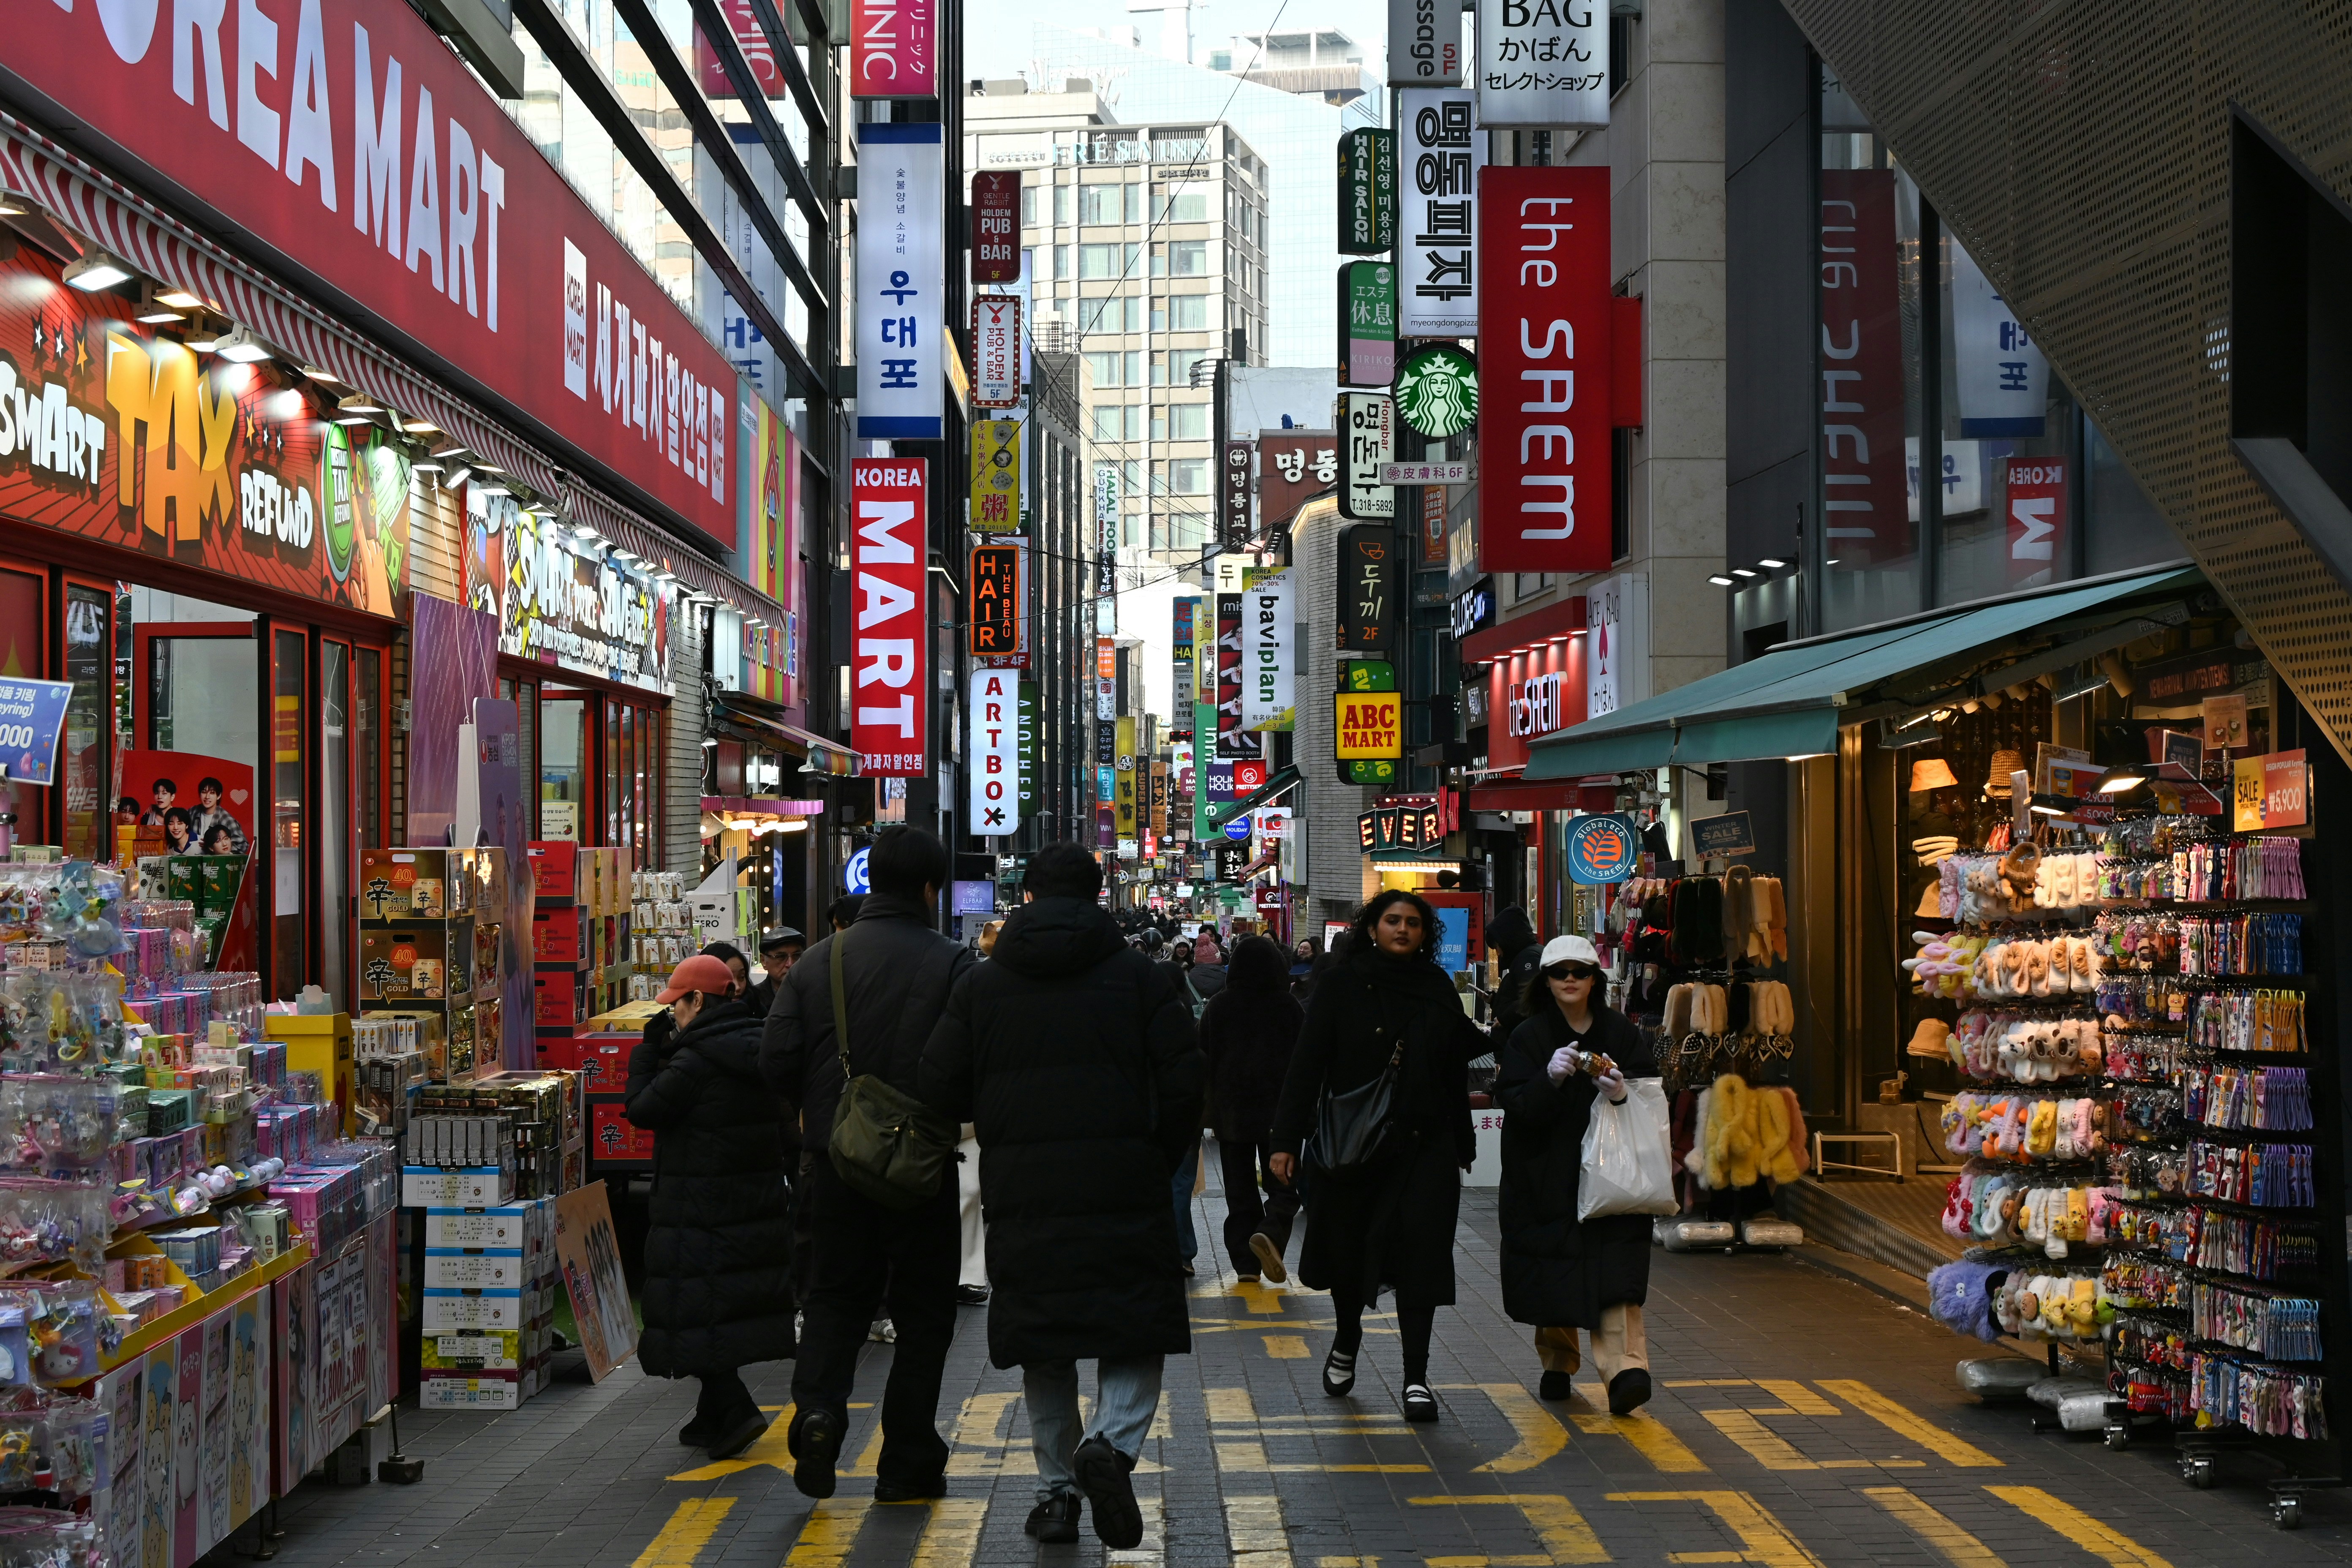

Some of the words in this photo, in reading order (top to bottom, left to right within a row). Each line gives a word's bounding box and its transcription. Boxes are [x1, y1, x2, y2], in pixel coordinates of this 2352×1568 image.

[1503, 0, 1592, 27] BAG
[1443, 44, 1456, 75] 5F
[1499, 36, 1591, 63] かばん
[1485, 72, 1604, 91] セレクトショップ
[1355, 135, 1367, 181] HAIR
[1377, 137, 1390, 190] 김선영
[354, 21, 504, 333] MART
[896, 168, 906, 214] 숯불양념
[1416, 101, 1472, 302] 명동피자
[981, 218, 1011, 234] PUB
[1354, 185, 1368, 243] SALON
[1377, 195, 1392, 245] 미용실
[896, 221, 906, 255] 소갈비
[1521, 198, 1573, 288] the
[981, 245, 1011, 260] BAR
[991, 270, 1000, 279] 5F
[1375, 272, 1390, 280] 明洞
[566, 272, 584, 318] KOREA
[1356, 286, 1388, 298] エステ
[1351, 300, 1393, 325] 休息
[1411, 319, 1478, 328] myeongdongpizza
[880, 270, 917, 388] 우대포
[566, 326, 584, 369] MART
[995, 328, 1004, 380] HOLDEM
[1352, 354, 1391, 365] KIRIKO
[594, 281, 707, 487] 세계과자할인점
[1338, 373, 1346, 383] 4F
[990, 389, 1001, 398] 5F
[1339, 396, 1346, 406] 3F
[0, 361, 105, 485] SMART
[106, 329, 236, 541] TAX
[241, 471, 313, 549] REFUND
[713, 411, 723, 445] KOREA
[1381, 400, 1390, 451] Hongbar
[331, 447, 347, 467] INSTANT
[1353, 403, 1380, 495] 명돈가
[713, 457, 723, 483] MART
[855, 468, 921, 487] KOREA
[1275, 448, 1337, 483] 명동
[1403, 466, 1446, 480] 皮膚科
[1449, 467, 1463, 478] 6F
[332, 468, 348, 502] TAX
[1106, 470, 1115, 514] HALAL
[334, 504, 350, 525] REFUND
[981, 493, 1009, 523] 粥
[1352, 499, 1393, 512] T.318-5892
[1449, 529, 1460, 577] JUNO
[1460, 517, 1473, 567] HAIR
[520, 528, 574, 617] SMART
[574, 579, 597, 630] PRICE
[600, 562, 635, 645] SAVE
[632, 603, 645, 646] BIG
[1359, 564, 1383, 621] 두끼
[979, 555, 997, 647] HAIR
[1176, 602, 1192, 626] 足
[1451, 589, 1473, 640] FULORE
[529, 618, 542, 646] SKIP
[858, 501, 915, 738] MART
[1337, 636, 1345, 648] 2F
[1363, 627, 1379, 640] 2F
[993, 656, 1007, 666] 3F
[1011, 656, 1025, 665] 4F
[1258, 596, 1279, 702] baviplan
[1338, 662, 1345, 672] 1F
[14, 689, 36, 702] 키링
[1594, 683, 1614, 714] かばん
[1343, 704, 1394, 730] ABC
[1509, 684, 1523, 737] the
[984, 677, 1005, 826] ARTBOX
[1019, 700, 1031, 800] ANOTHER
[1343, 731, 1395, 748] MART
[2173, 745, 2194, 754] WINTER
[2170, 753, 2195, 768] SALE
[2266, 762, 2277, 771] DESIGN
[2277, 760, 2291, 769] POPULAR
[2292, 759, 2303, 768] Keyring
[1102, 773, 1110, 796] 하모니
[2238, 781, 2258, 803] SALE
[1360, 813, 1438, 846] EVER
[1577, 822, 1607, 839] global
[1610, 824, 1624, 837] eco
[1701, 826, 1742, 841] SALE
[1704, 821, 1737, 831] WINTER
[1224, 850, 1244, 862] 명동
[1584, 865, 1596, 877] the
[366, 877, 395, 916] 辛
[366, 957, 395, 996] 辛
[581, 1056, 603, 1088] 辛
[600, 1123, 623, 1154] 辛
[324, 1265, 335, 1281] Candy
[348, 1255, 359, 1267] Candy
[354, 1267, 364, 1281] songs
[320, 1288, 331, 1306] playing
[332, 1281, 340, 1295] songs
